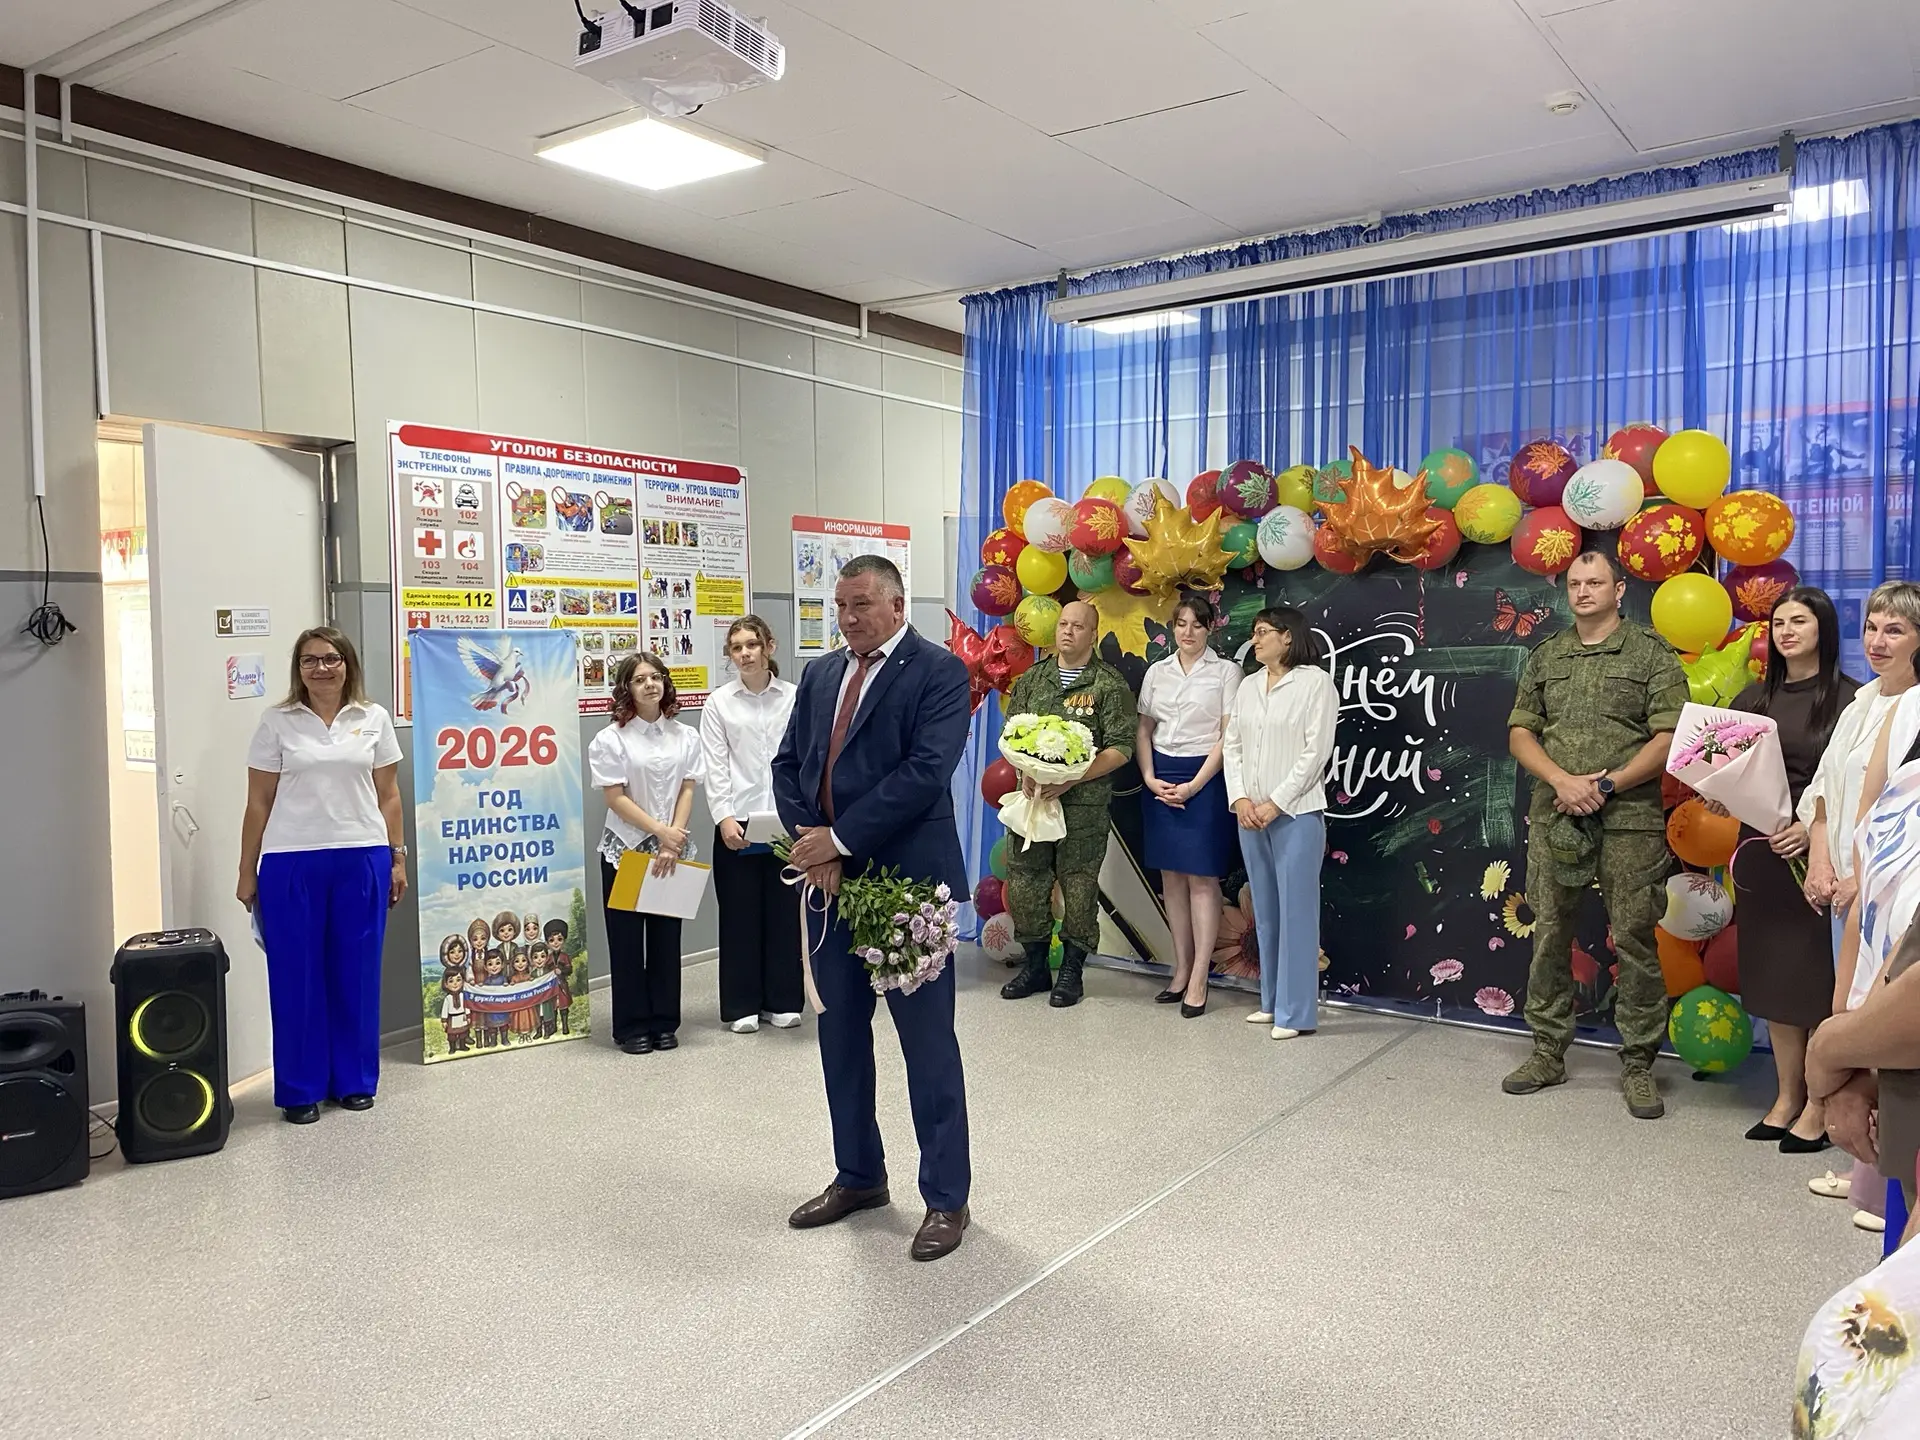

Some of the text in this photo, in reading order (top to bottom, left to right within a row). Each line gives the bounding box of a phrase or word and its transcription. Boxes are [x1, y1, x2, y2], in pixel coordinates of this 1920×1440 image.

[419, 450, 471, 464] ТЕЛЕФОНЫ
[489, 439, 678, 474] УГОЛОК БЕЗОПАСНОСТИ
[397, 459, 493, 478] ЭКСТРЕННЫХ СЛУЖБ
[505, 462, 632, 487] ПРАВИЛА ДОРОЖНОГО ДВИЖЕНИЯ
[644, 479, 680, 493] ТЕРРОРИЗМ
[685, 483, 708, 496] УГРОЗА
[709, 485, 740, 499] ОБЩЕСТВУ
[666, 494, 724, 508] ВНИМАНИЕ!
[421, 508, 439, 517] 101
[459, 511, 478, 520] 102
[824, 521, 883, 536] ИНФОРМАЦИЯ
[422, 560, 440, 569] 103
[461, 562, 479, 571] 104
[522, 577, 558, 586] Пользуйтесь
[405, 599, 430, 607] службы
[464, 592, 493, 607] 112
[411, 611, 428, 619] SOS
[435, 614, 490, 625] 121, 122, 123
[508, 617, 548, 626] Внимание!
[437, 725, 558, 770] 2026
[478, 789, 522, 811] ГОД
[441, 813, 560, 840] ЕДИНСТВА
[449, 839, 555, 865] НАРОДОВ
[457, 866, 548, 891] РОССИИ
